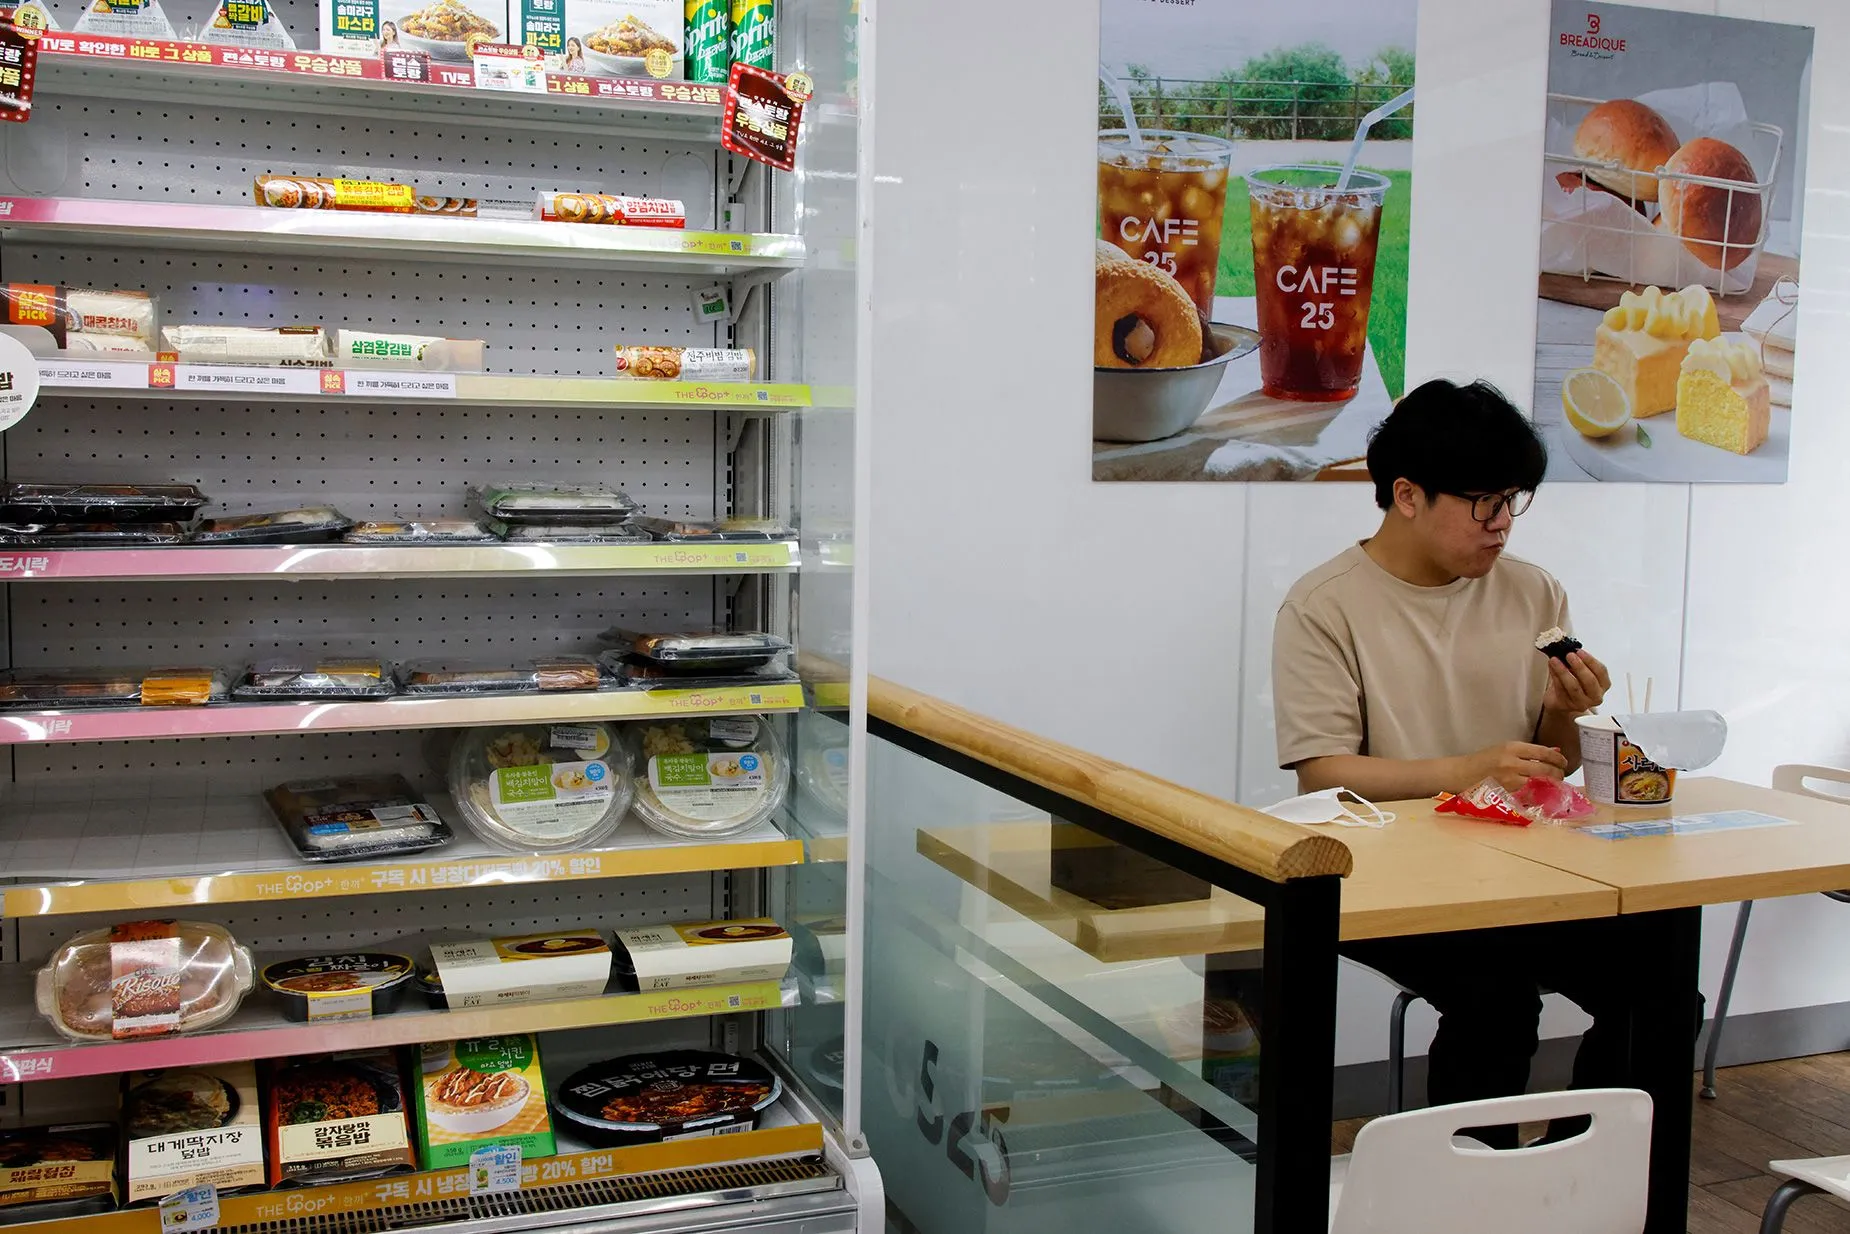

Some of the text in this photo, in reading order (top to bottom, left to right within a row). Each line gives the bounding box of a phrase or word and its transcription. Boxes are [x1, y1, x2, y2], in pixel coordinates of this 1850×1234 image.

[337, 16, 375, 32] 파스타
[525, 32, 561, 48] 파스타
[1560, 33, 1626, 52] BREADIQUE
[41, 37, 75, 52] TV로
[79, 40, 126, 56] 확인한
[164, 47, 180, 60] 그
[294, 55, 363, 76] 우승상품
[440, 71, 471, 85] TV로
[547, 80, 562, 91] 그
[660, 86, 721, 103] 우승상품
[626, 200, 670, 214] 양념치킨
[1119, 216, 1199, 247] CAFE
[1276, 265, 1358, 296] CAFE
[18, 310, 48, 321] PICK
[1300, 302, 1335, 330] 25
[352, 340, 412, 357] 삼겹왕김밥
[686, 350, 724, 363] 전주비빔
[234, 377, 255, 385] 드리고
[675, 391, 694, 399] THE
[0, 556, 49, 572] 도시락
[654, 555, 673, 563] THE
[669, 699, 690, 708] THE
[256, 882, 284, 895] THE
[371, 869, 405, 888] 구독
[410, 868, 426, 885] 시
[570, 857, 601, 875] 할인
[648, 1005, 669, 1014] THE
[501, 1046, 525, 1060] 치킨
[314, 1121, 371, 1138] 감자탕맛
[147, 1131, 243, 1154] 대게딱지장
[315, 1132, 371, 1149] 볶음밥
[181, 1147, 211, 1160] 덮밥
[495, 1153, 517, 1166] 할인
[255, 1203, 284, 1219] THE
[375, 1180, 410, 1202] 구독
[416, 1179, 432, 1196] 시
[542, 1160, 576, 1180] 20%
[581, 1154, 613, 1173] 할인
[185, 1188, 213, 1204] 할인
